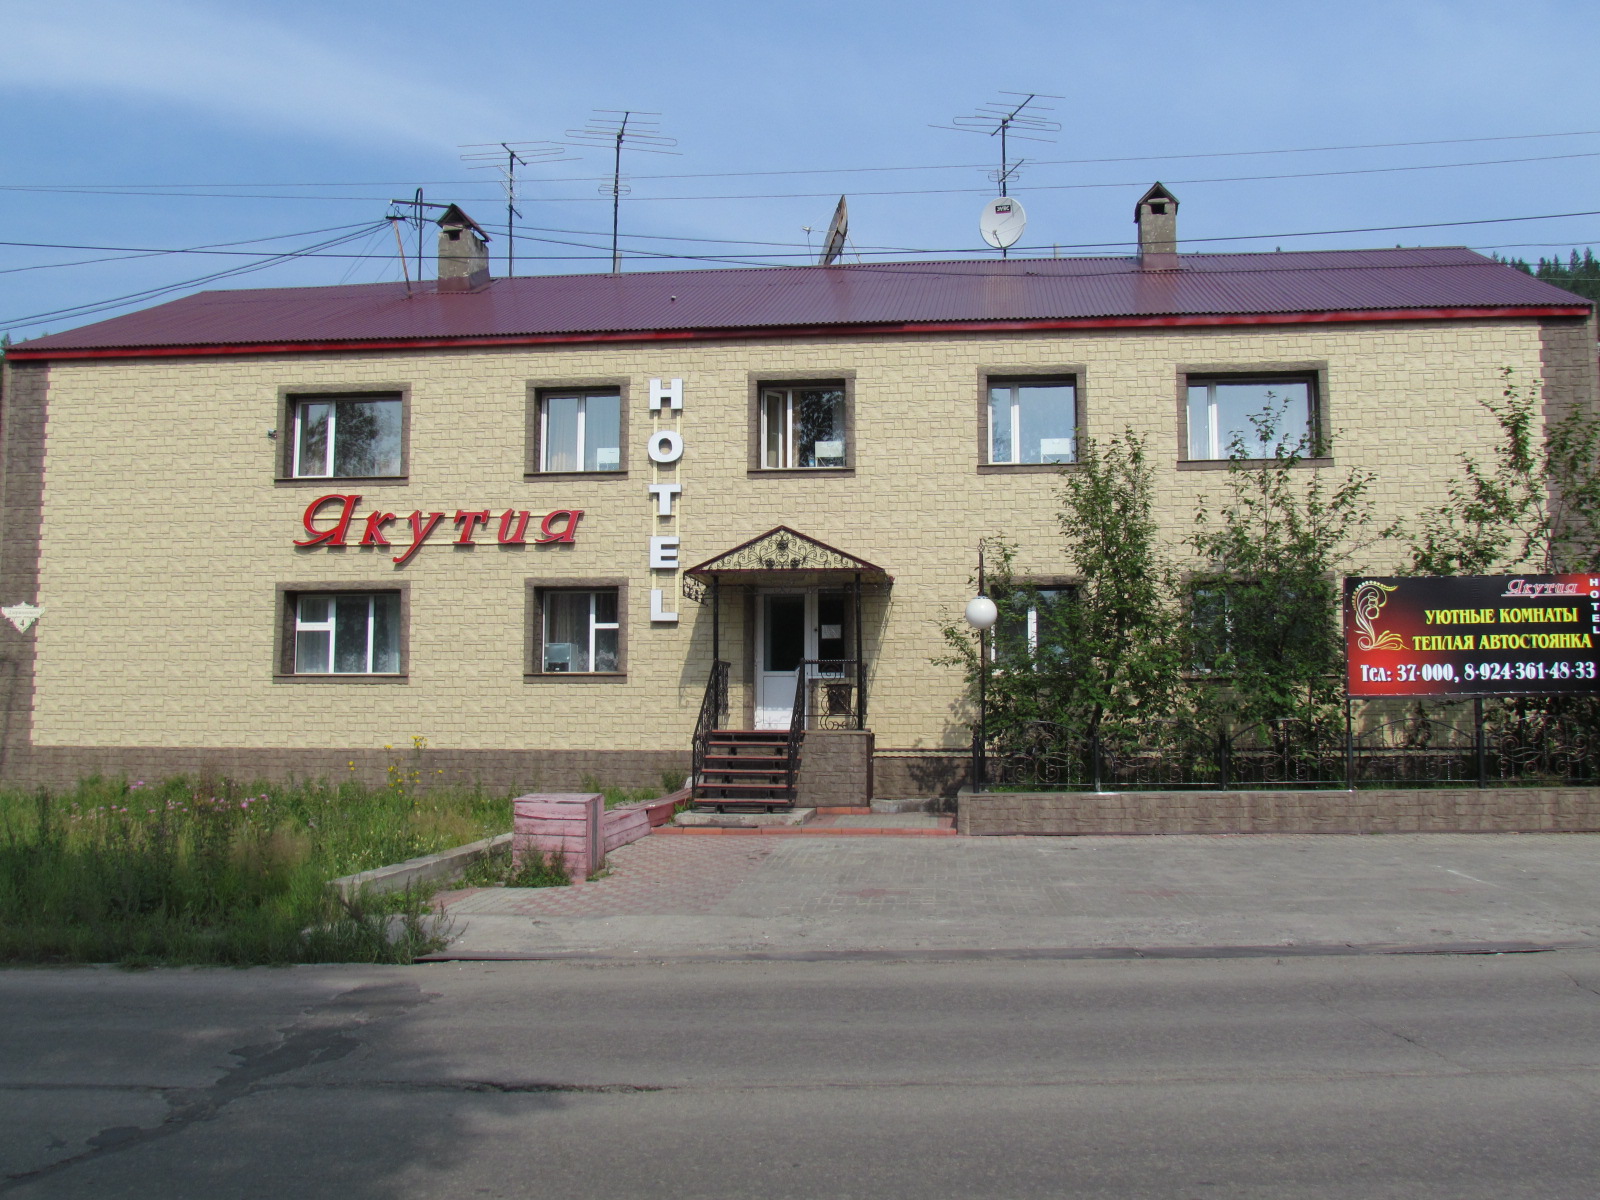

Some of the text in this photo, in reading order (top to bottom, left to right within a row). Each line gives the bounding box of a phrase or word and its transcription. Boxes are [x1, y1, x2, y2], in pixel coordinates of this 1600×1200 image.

[648, 378, 684, 622] HOTEL
[292, 493, 585, 563] Якутия
[1506, 579, 1578, 598] Якутия
[1589, 578, 1600, 634] HOTEL
[1425, 607, 1578, 625] УЮТНЫЕ КОМНАТЫ
[1412, 633, 1593, 650] ТЕПЛАЯ АВТОСТОЯНКА
[1360, 664, 1392, 682] Тел:
